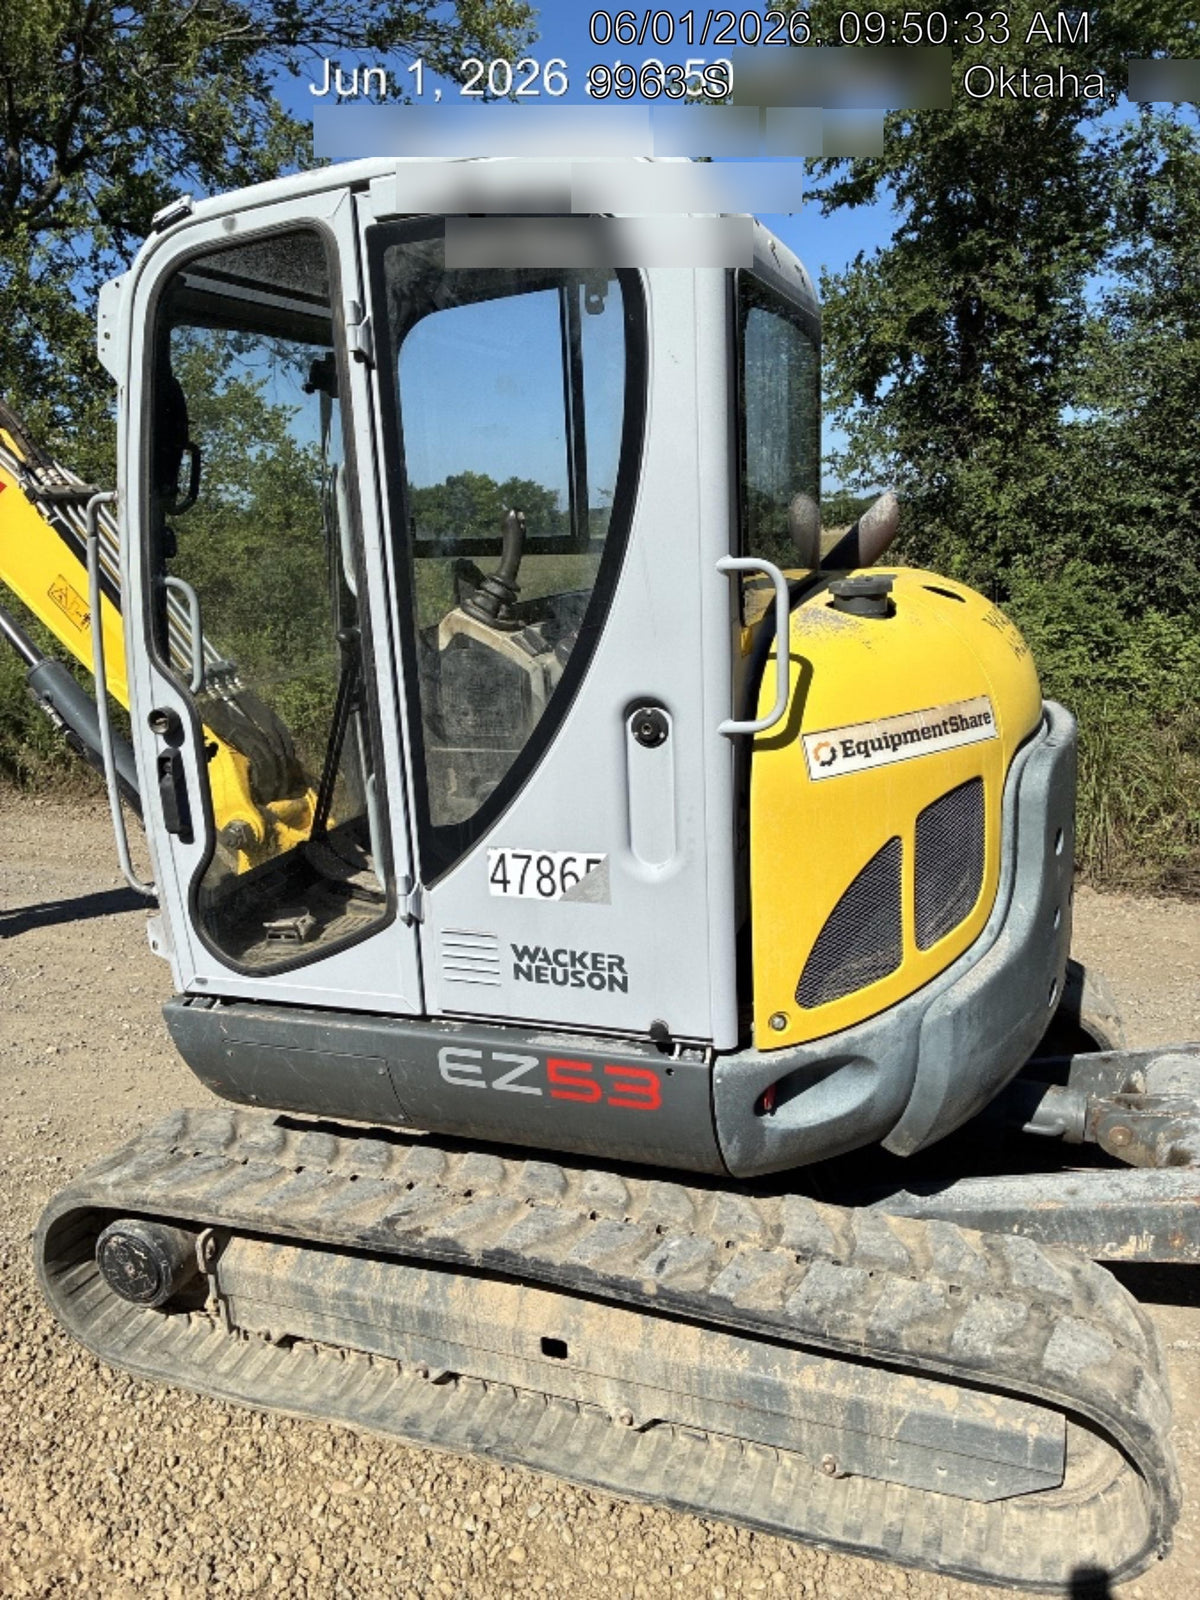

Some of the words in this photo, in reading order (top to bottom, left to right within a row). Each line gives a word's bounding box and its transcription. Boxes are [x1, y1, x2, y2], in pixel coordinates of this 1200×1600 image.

[840, 710, 993, 759] EquipmentShare
[510, 943, 628, 974] WACKER
[513, 962, 629, 994] NEUSON
[437, 1046, 662, 1111] EZ53
